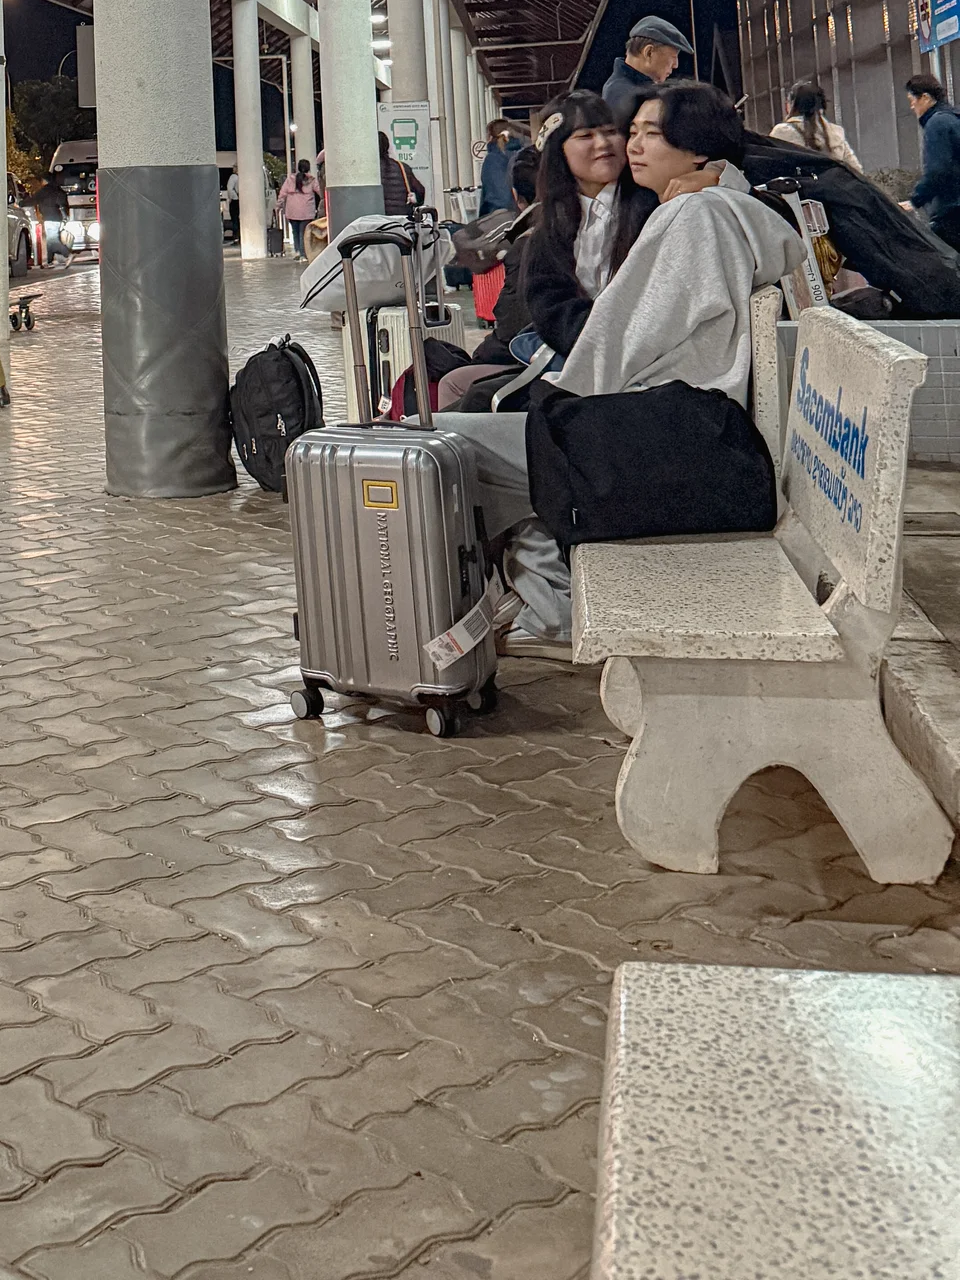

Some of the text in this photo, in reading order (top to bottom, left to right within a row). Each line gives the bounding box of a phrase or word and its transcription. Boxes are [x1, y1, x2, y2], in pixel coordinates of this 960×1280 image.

[398, 152, 414, 161] BUS
[797, 346, 869, 480] Sacombank
[376, 512, 400, 662] NATIONAL GEOGRAPHIC
